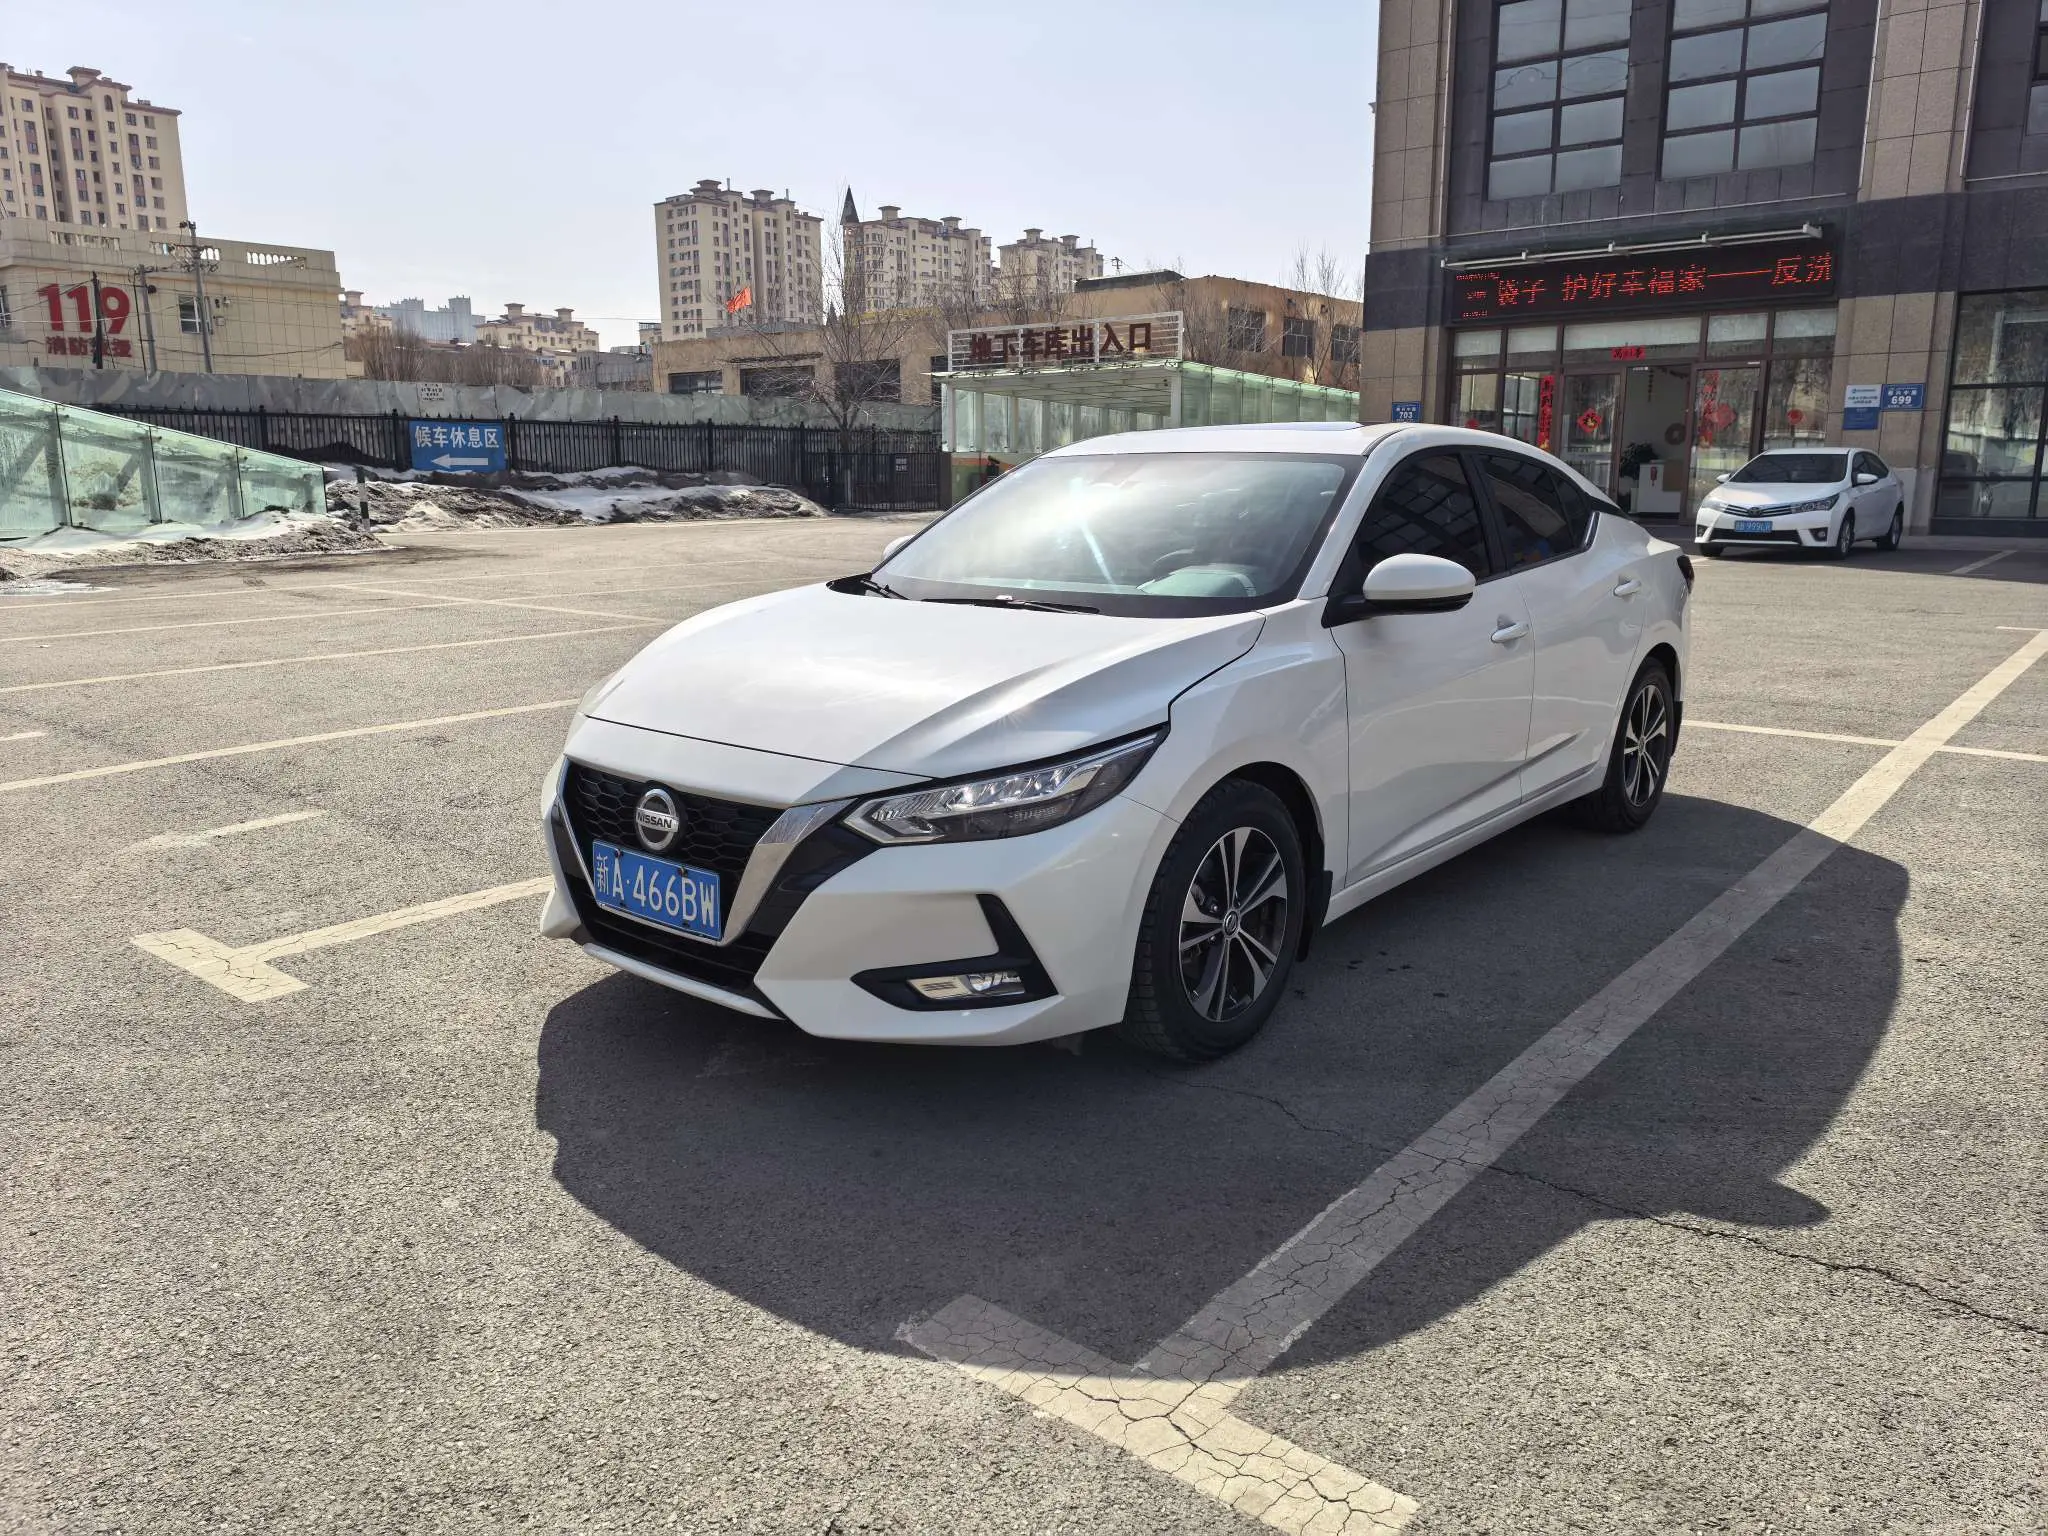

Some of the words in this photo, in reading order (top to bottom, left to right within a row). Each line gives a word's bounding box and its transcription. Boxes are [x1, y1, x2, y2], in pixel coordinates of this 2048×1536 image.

[35, 283, 130, 334] 119
[970, 322, 1152, 363] 地下车库出入口
[1891, 395, 1912, 405] 699
[1399, 411, 1413, 419] 703
[414, 425, 499, 449] 候车休息区
[637, 811, 673, 829] NISSAN
